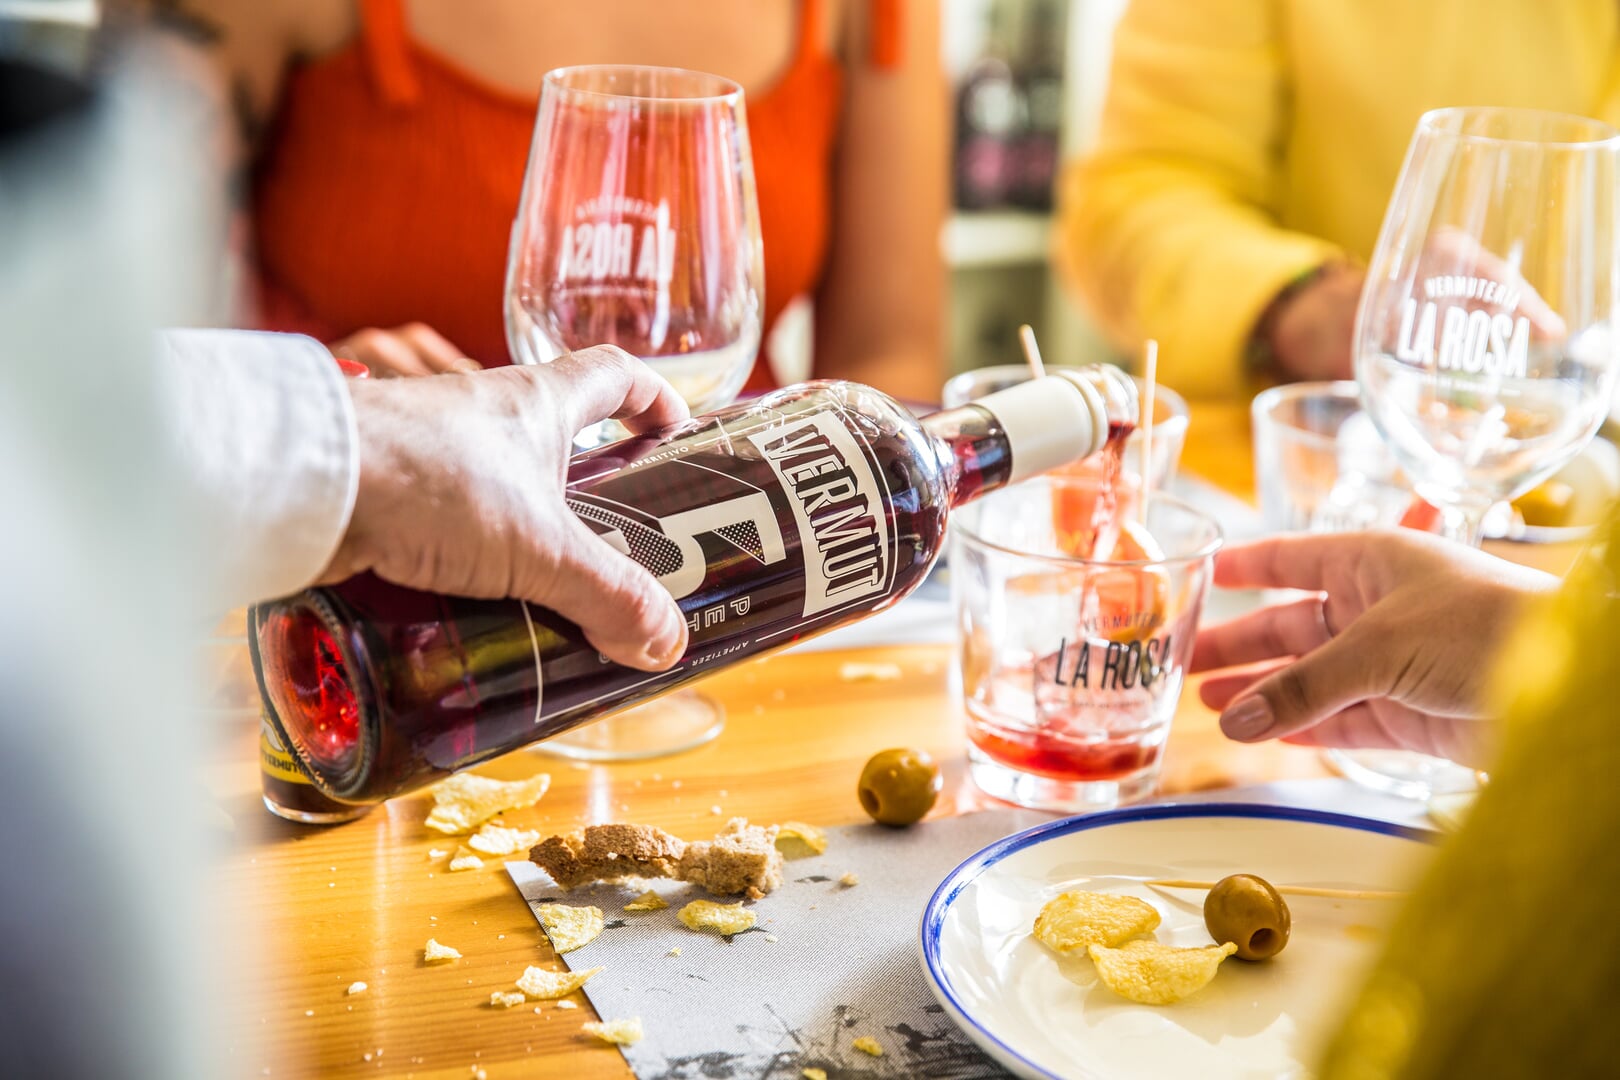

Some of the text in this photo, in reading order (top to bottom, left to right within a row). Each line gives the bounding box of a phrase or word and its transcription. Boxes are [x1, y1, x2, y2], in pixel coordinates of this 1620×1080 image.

[1397, 298, 1530, 378] LA ROSA
[629, 446, 689, 469] APERITIVO
[764, 423, 887, 597] VERMUT
[692, 640, 749, 667] APPETIZER
[1055, 634, 1171, 690] LA ROSA
